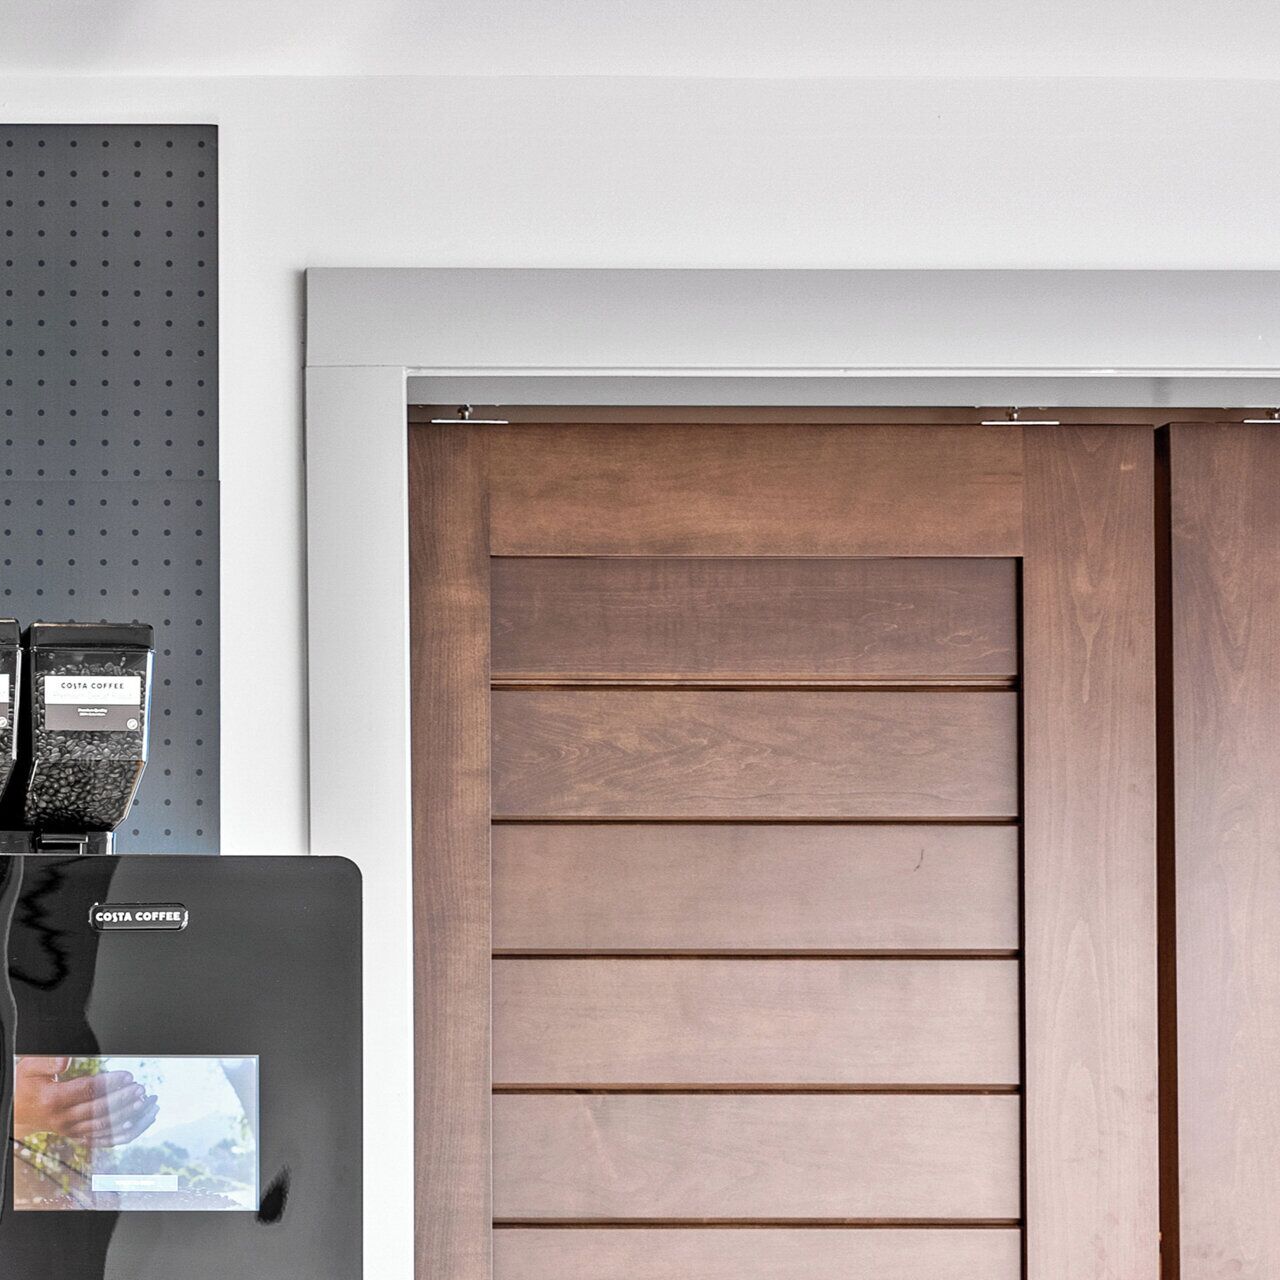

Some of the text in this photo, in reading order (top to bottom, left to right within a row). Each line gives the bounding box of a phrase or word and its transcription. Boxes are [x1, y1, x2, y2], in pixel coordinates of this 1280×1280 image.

[61, 682, 124, 690] COSTA COFFEE
[95, 911, 181, 922] COSTA COFFEE
